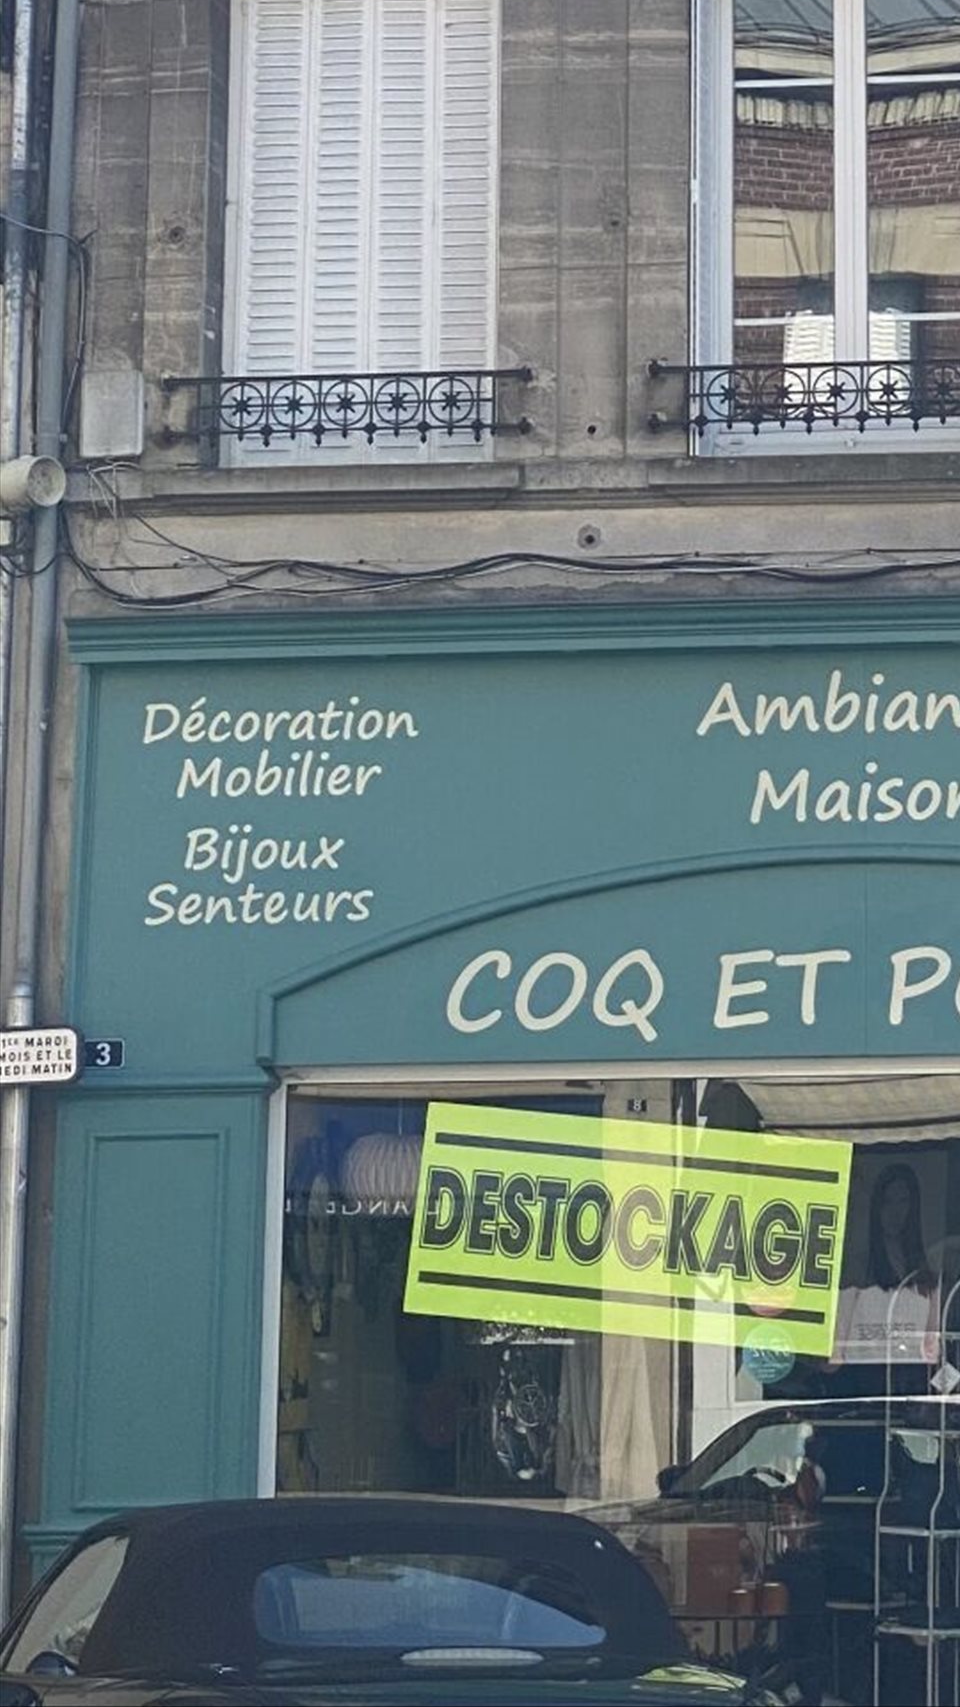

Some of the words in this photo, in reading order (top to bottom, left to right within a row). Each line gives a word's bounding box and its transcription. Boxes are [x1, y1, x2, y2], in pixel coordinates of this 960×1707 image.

[143, 696, 419, 745] Décoration
[176, 750, 382, 799] Mobilier
[184, 824, 345, 884] Bijoux
[144, 882, 374, 926] Senteurs
[446, 949, 664, 1042] COQ
[713, 949, 852, 1029] ET
[25, 1036, 67, 1048] MARDI
[36, 1050, 52, 1061] ET
[57, 1049, 72, 1060] LE
[96, 1042, 111, 1066] 3
[0, 1065, 26, 1076] EDI
[31, 1063, 72, 1074] MATIN
[418, 1165, 838, 1290] DESTOCKAGE
